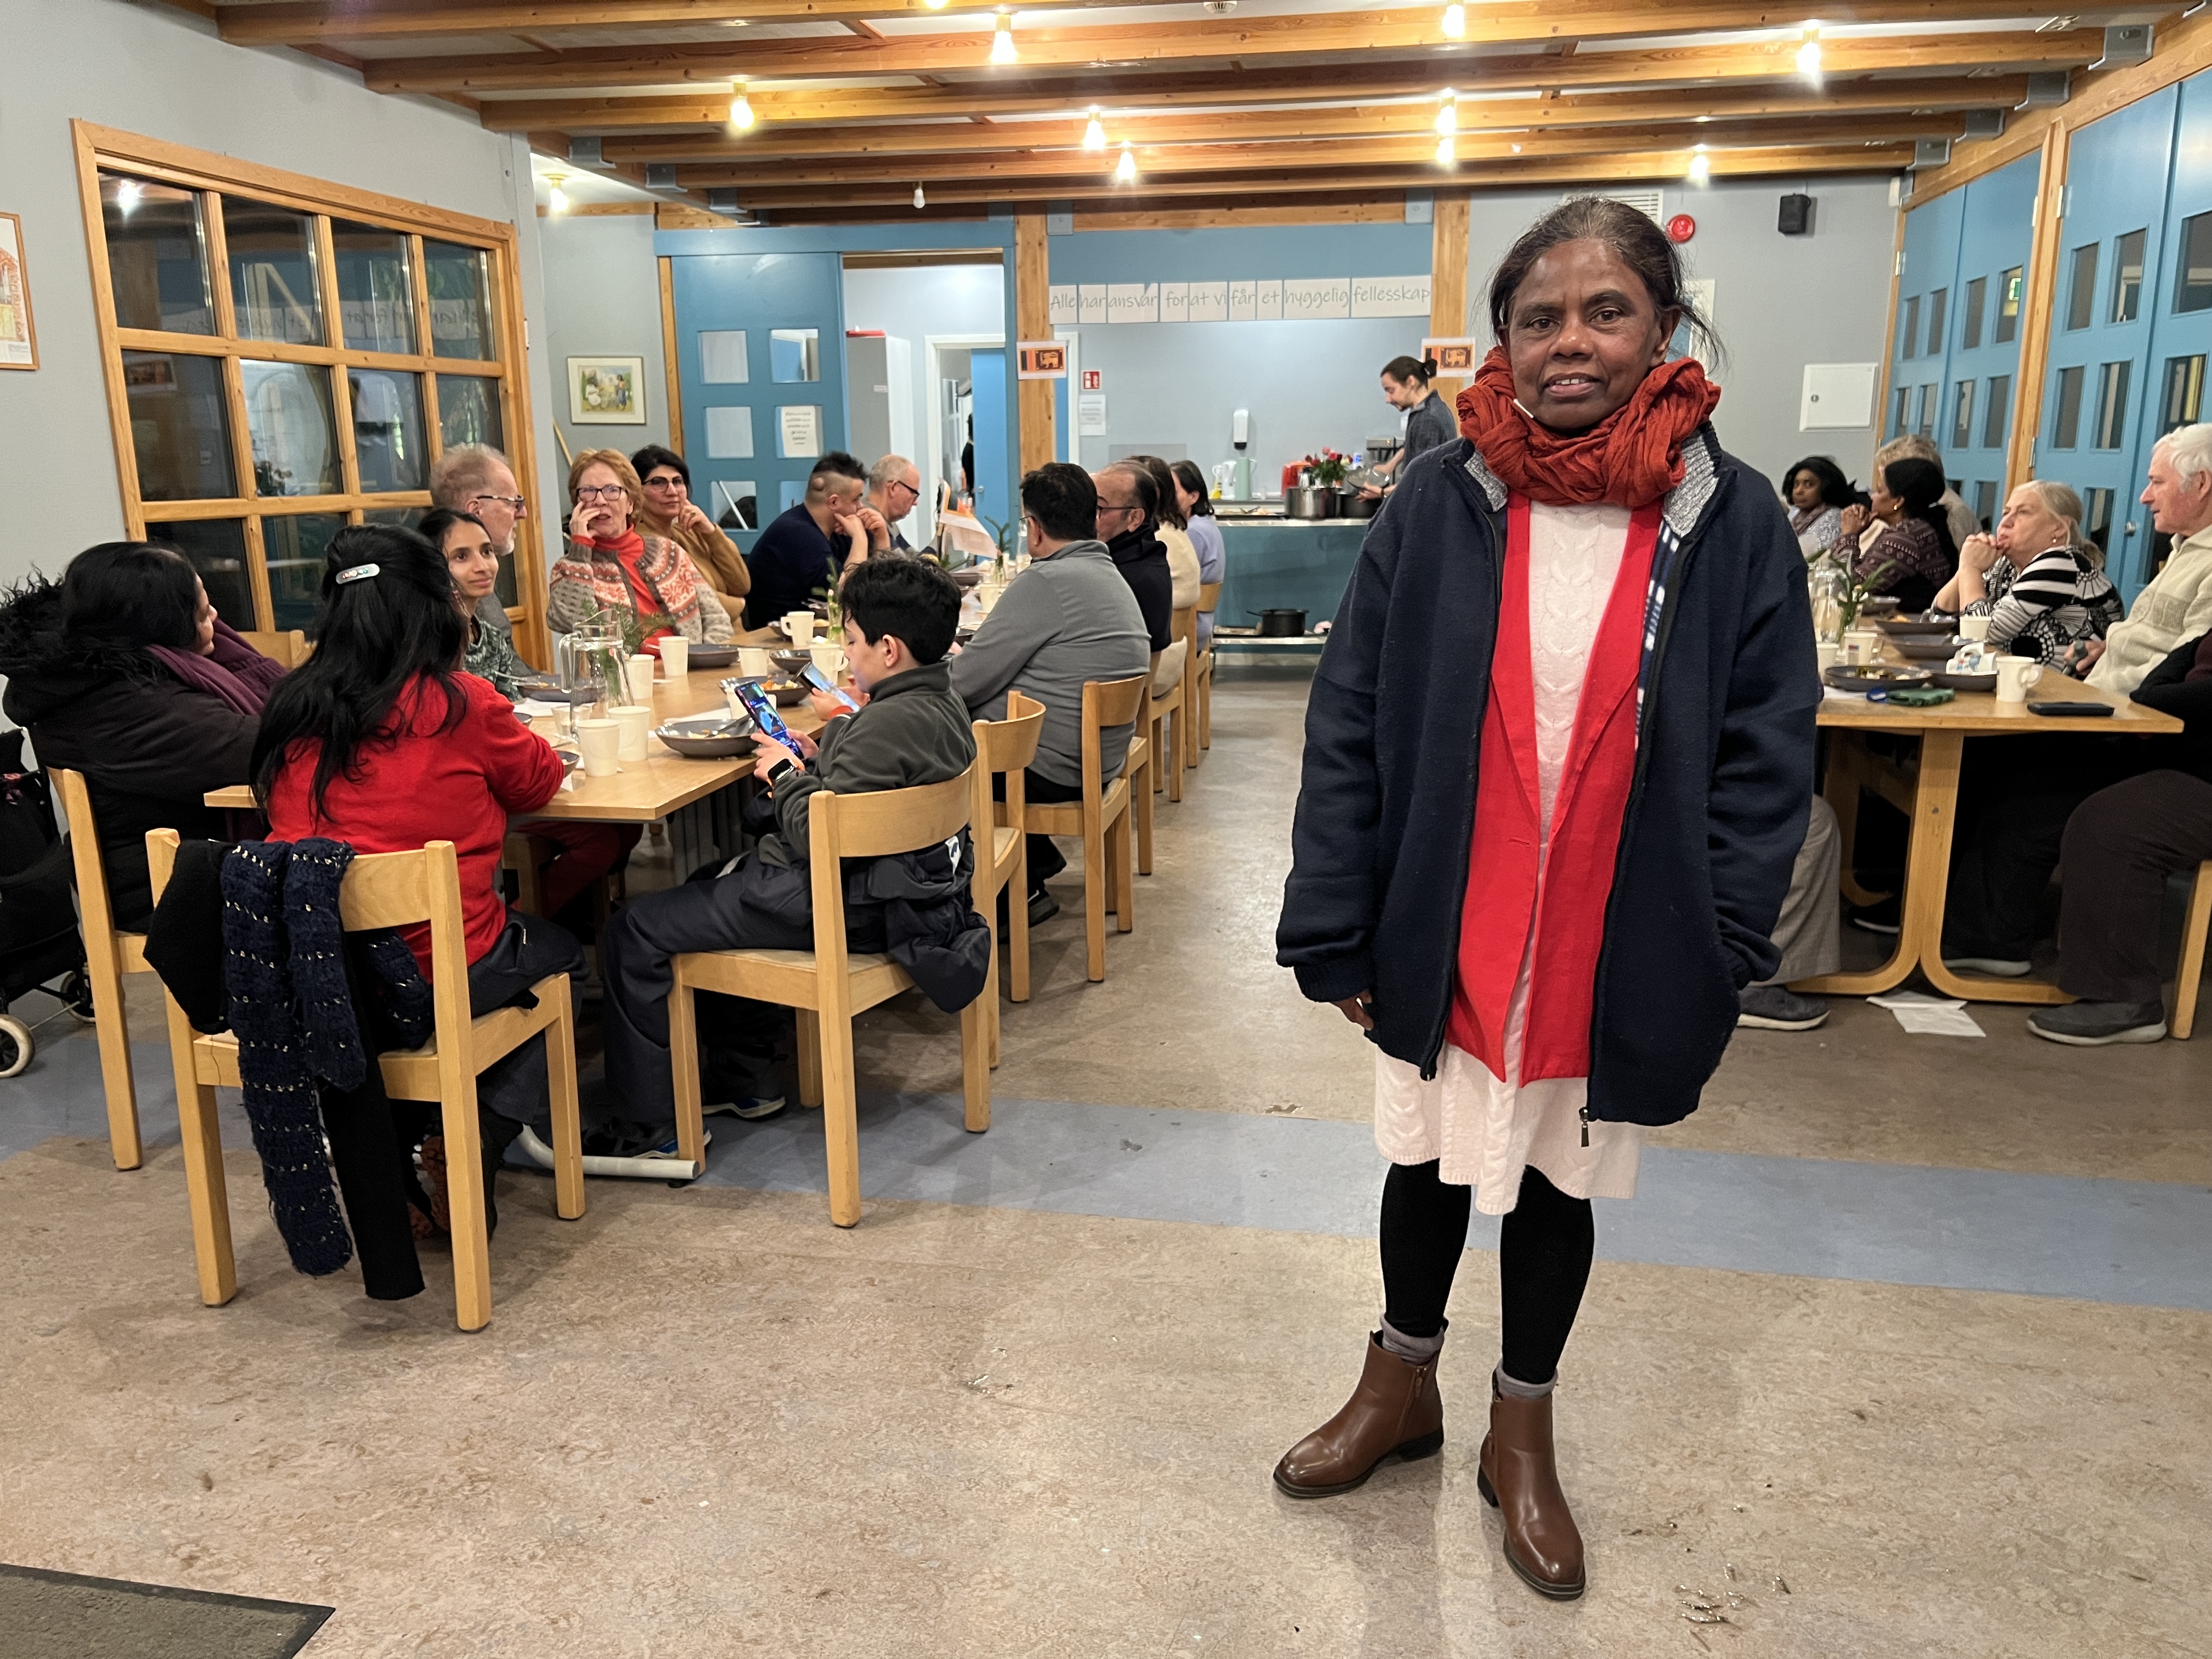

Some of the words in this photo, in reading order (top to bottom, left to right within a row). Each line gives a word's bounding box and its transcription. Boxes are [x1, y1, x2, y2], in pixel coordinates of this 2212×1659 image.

[1050, 293, 1075, 311] Alle
[1079, 294, 1105, 308] har
[1108, 295, 1158, 308] ansvar
[1165, 291, 1187, 308] for
[1189, 291, 1209, 307] at
[1213, 290, 1227, 306] vi
[1231, 289, 1255, 307] får
[1262, 290, 1280, 304] et
[1285, 288, 1348, 309] hyggelig
[1353, 285, 1430, 303] fellesskap
